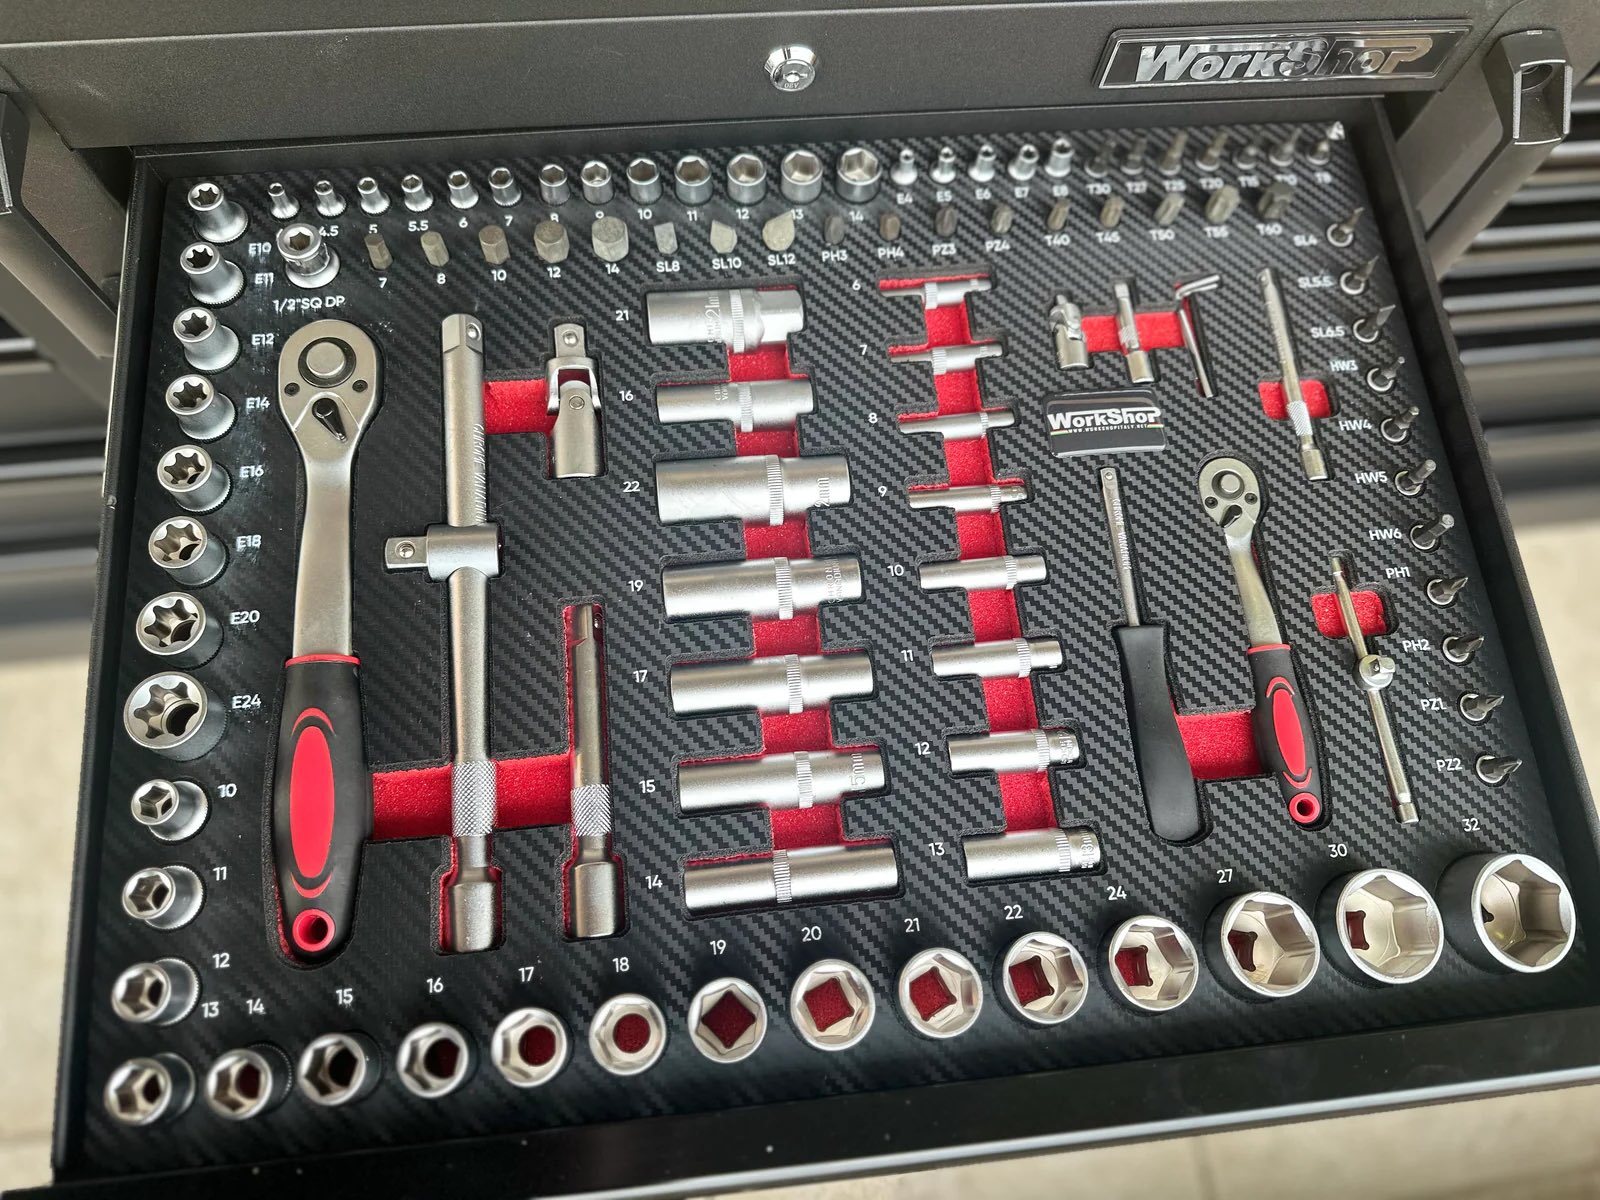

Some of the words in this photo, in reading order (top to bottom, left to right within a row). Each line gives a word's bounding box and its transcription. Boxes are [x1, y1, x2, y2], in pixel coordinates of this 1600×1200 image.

[1125, 181, 1148, 193] T27
[1163, 180, 1187, 192] T25
[1199, 178, 1224, 189] T20
[1238, 176, 1259, 187] T15
[975, 188, 991, 200] E6
[1014, 187, 1030, 198] E7
[1087, 183, 1111, 194] T30
[896, 193, 913, 204] E4
[936, 191, 952, 202] E5
[637, 209, 652, 220] 10
[686, 210, 698, 222] 11
[736, 209, 750, 220] 12
[791, 209, 804, 220] 13
[849, 211, 864, 222] 14
[408, 220, 429, 231] 5.5
[459, 217, 468, 228] 6
[504, 215, 514, 227] 7
[318, 225, 339, 237] 4.5
[1203, 226, 1229, 238] T55
[1256, 223, 1283, 235] T60
[1044, 235, 1070, 246] T40
[1096, 232, 1121, 244] T45
[1150, 230, 1175, 241] T50
[1293, 235, 1318, 247] SL4
[248, 242, 272, 254] E10
[932, 243, 956, 255] PZ3
[985, 240, 1010, 252] PZ4
[822, 250, 848, 262] PH3
[878, 247, 904, 259] PH4
[712, 258, 742, 271] SL10
[767, 254, 796, 266] SL12
[606, 263, 620, 275] 14
[655, 260, 680, 273] SL8
[255, 272, 274, 286] E11
[437, 273, 446, 285] 8
[491, 269, 507, 281] 10
[547, 267, 561, 279] 12
[378, 277, 388, 289] 7
[852, 279, 861, 290] 6
[1298, 276, 1333, 289] SL5.5
[325, 296, 345, 307] DP
[615, 310, 630, 321] 21
[1310, 326, 1345, 339] SL6.5
[252, 333, 274, 346] E12
[859, 344, 868, 356] 7
[1330, 360, 1358, 372] HW3
[619, 390, 634, 402] 16
[246, 396, 270, 409] E14
[868, 412, 878, 424] 8
[1339, 419, 1372, 432] HW4
[239, 464, 264, 478] E16
[1355, 471, 1388, 484] HW5
[622, 480, 640, 493] 22
[878, 485, 888, 497] 9
[1369, 528, 1402, 541] HW6
[236, 535, 262, 550] E18
[887, 564, 905, 577] 10
[1385, 566, 1410, 579] PH1
[628, 579, 644, 592] 19
[229, 609, 260, 625] E20
[1402, 638, 1430, 651] PH2
[901, 649, 914, 662] 11
[633, 669, 648, 683] 17
[232, 694, 262, 709] E24
[915, 742, 931, 755] 12
[1436, 758, 1463, 772] PZ2
[217, 784, 237, 798] 10
[638, 780, 655, 793] 15
[1462, 818, 1481, 832] 32
[928, 842, 945, 856] 13
[1328, 844, 1347, 858] 30
[213, 867, 227, 881] 11
[1217, 868, 1234, 885] 27
[645, 874, 662, 890] 14
[1106, 886, 1127, 901] 24
[1003, 904, 1023, 921] 22
[904, 918, 921, 934] 21
[801, 925, 822, 942] 20
[709, 939, 727, 956] 19
[212, 953, 230, 968] 12
[612, 957, 630, 973] 18
[518, 966, 534, 982] 17
[426, 977, 444, 993] 16
[335, 988, 353, 1005] 15
[202, 1001, 219, 1018] 13
[246, 999, 265, 1015] 14
